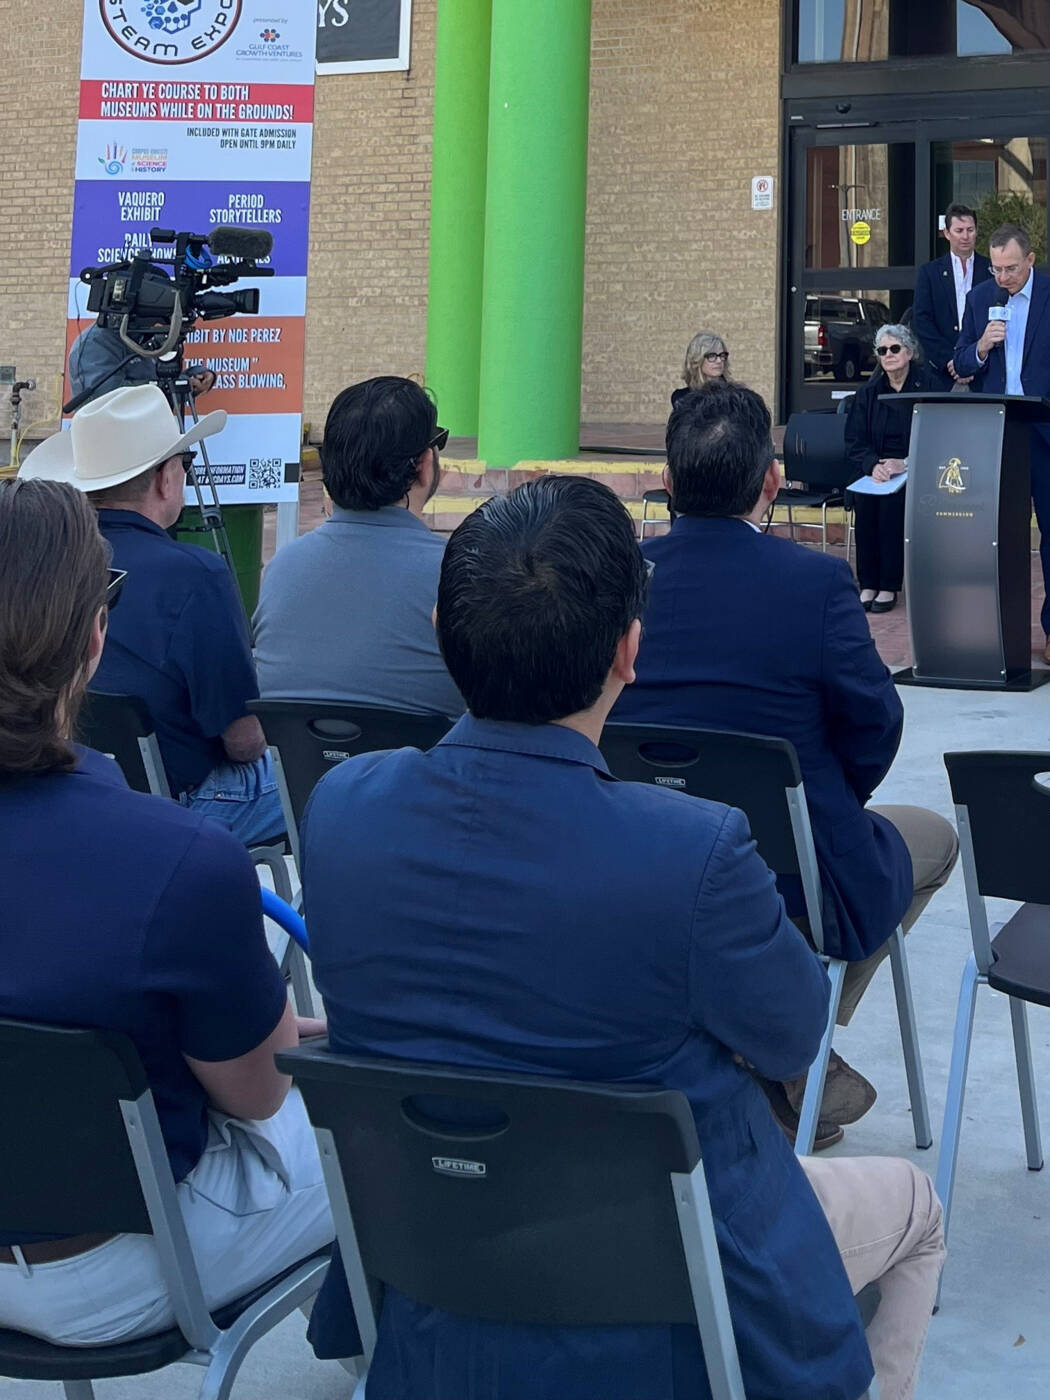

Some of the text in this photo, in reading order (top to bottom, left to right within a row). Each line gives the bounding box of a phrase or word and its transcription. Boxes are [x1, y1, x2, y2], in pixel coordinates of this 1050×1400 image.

[101, 83, 249, 101] CHART YE COURSE TO BOTH
[101, 101, 294, 120] MUSEUMS WHILE ON THE GROUNDS!
[187, 127, 297, 138] INCLUDED WITH GATE ADMISSION
[220, 138, 297, 149] OPEN UNTIL 9PM DAILY
[118, 191, 165, 207] VAQUERO
[228, 194, 264, 208] PERIOD
[120, 207, 161, 221] EXHIBIT
[209, 209, 282, 223] STORYTELLERS
[842, 209, 881, 220] ENTRANCE
[125, 232, 153, 248] DAILY
[213, 328, 281, 343] BY NOE PEREZ
[206, 357, 250, 372] MUSEUM
[238, 373, 287, 390] BLOWING,
[438, 1160, 480, 1173] LIFETIME
